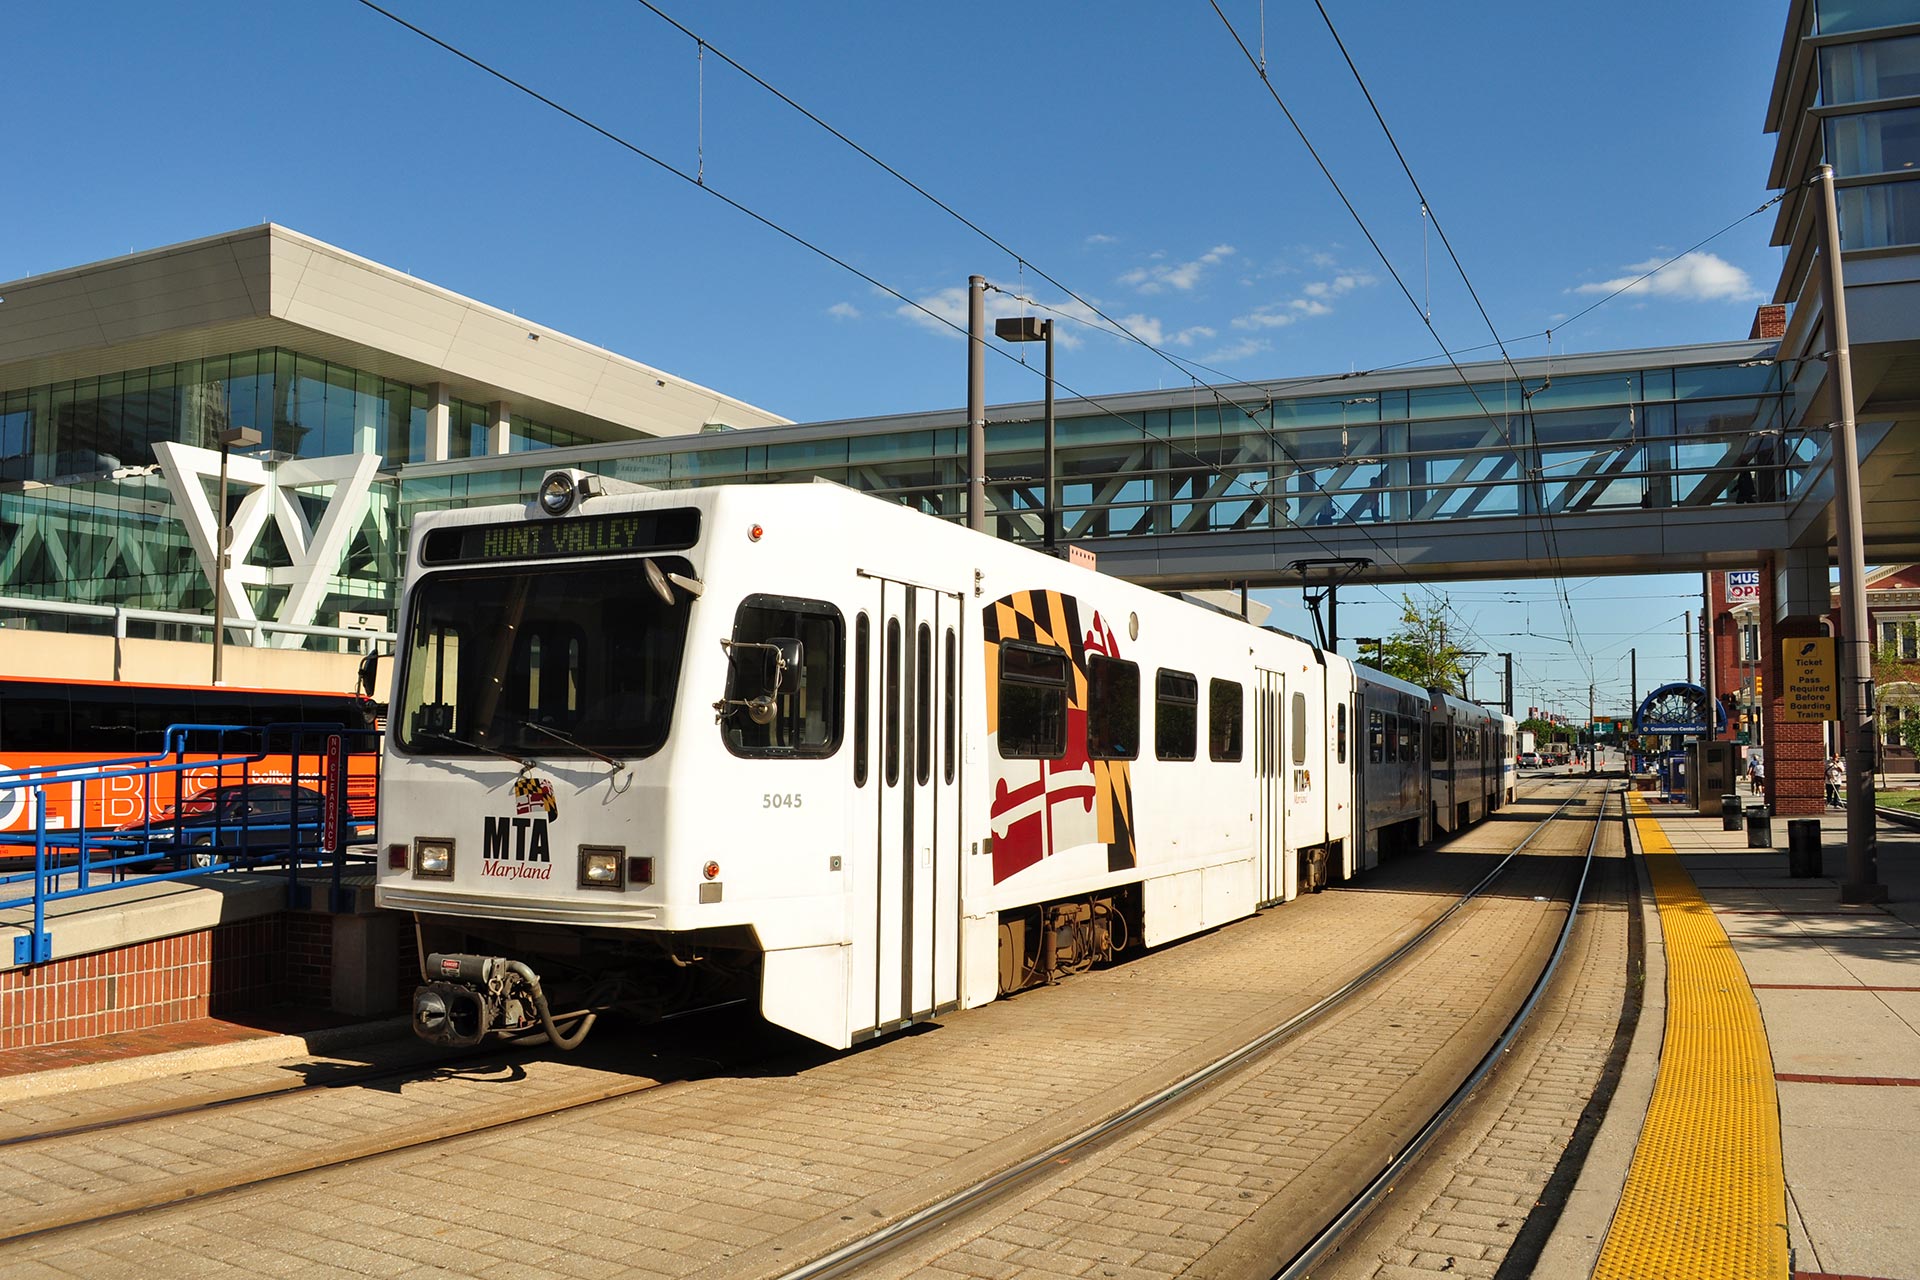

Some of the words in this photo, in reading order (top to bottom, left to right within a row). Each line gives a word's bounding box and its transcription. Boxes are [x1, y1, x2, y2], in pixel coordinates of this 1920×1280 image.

[484, 526, 543, 557] HUNT
[552, 518, 638, 552] VALLEY
[1731, 573, 1760, 584] MUS
[1790, 685, 1830, 693] Required
[1790, 702, 1831, 710] Boarding
[330, 738, 338, 755] NO
[327, 764, 336, 849] CLEARANCE
[762, 793, 802, 809] 5045
[483, 816, 550, 862] MTA
[481, 860, 552, 880] Maryland
